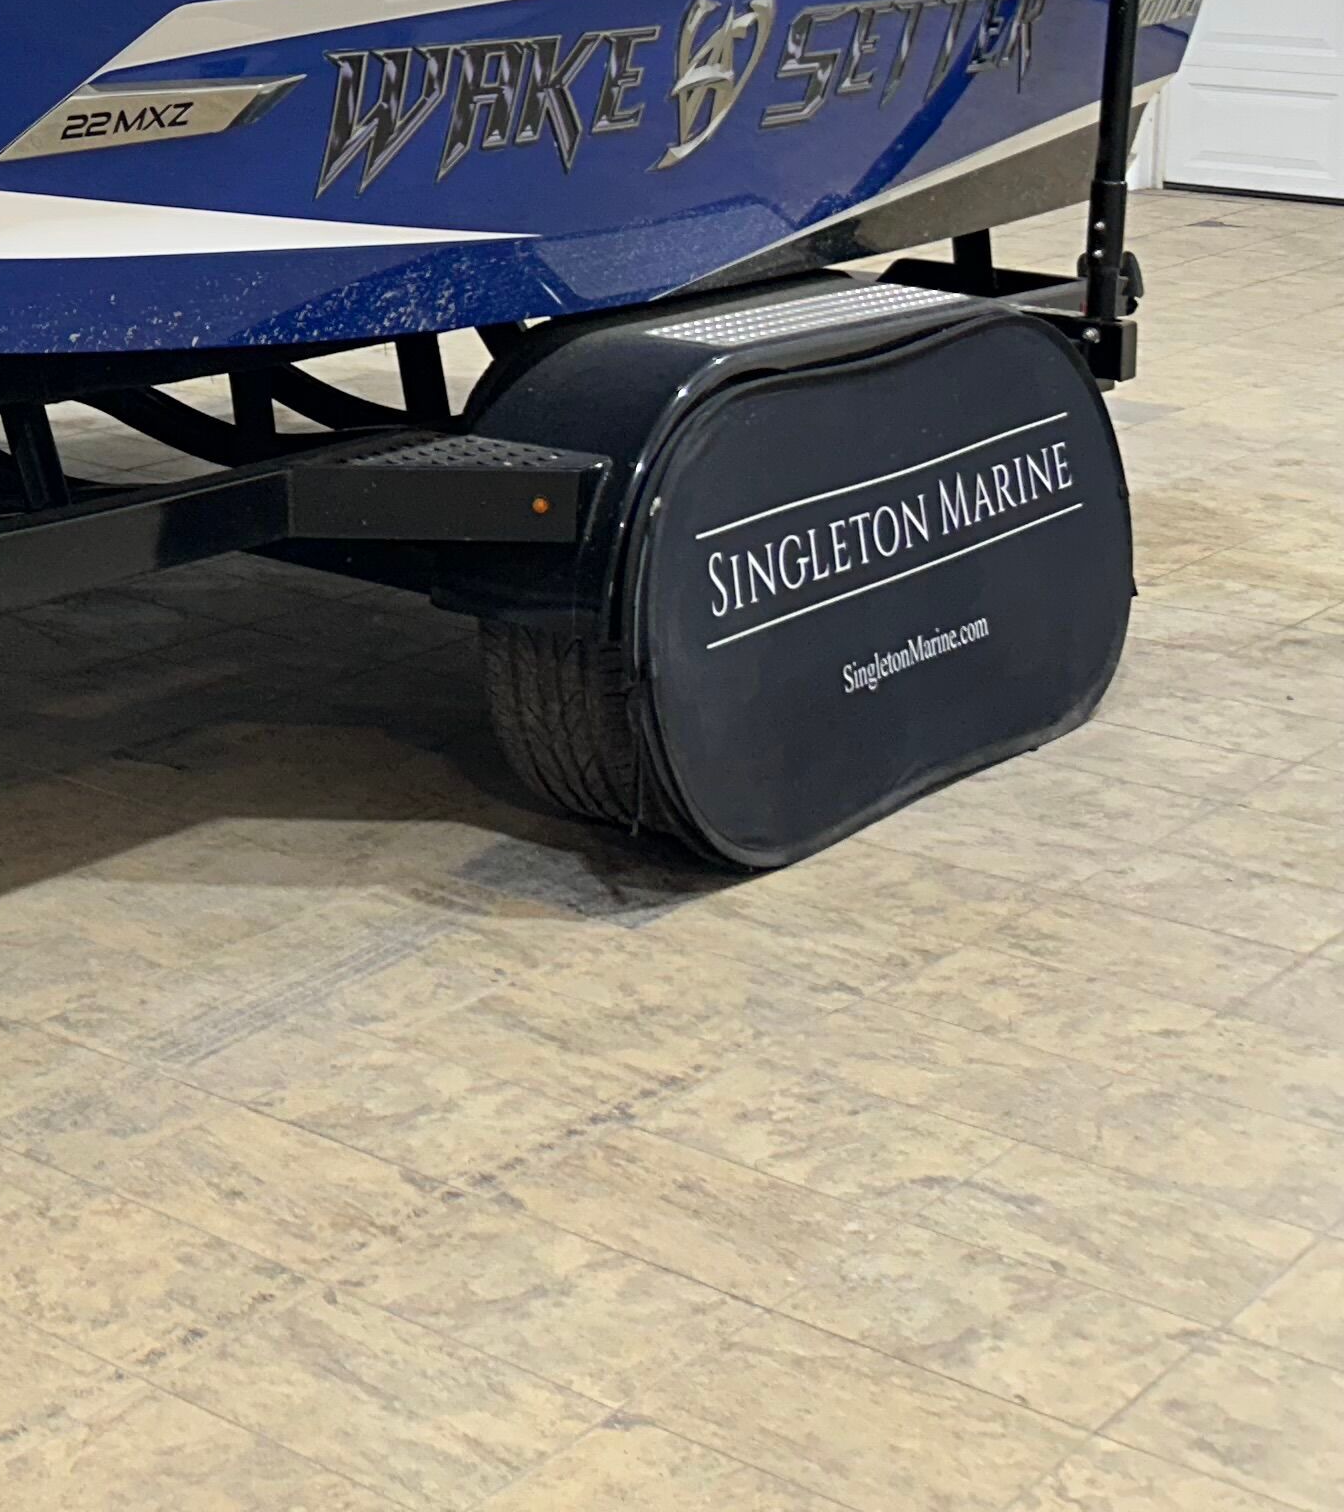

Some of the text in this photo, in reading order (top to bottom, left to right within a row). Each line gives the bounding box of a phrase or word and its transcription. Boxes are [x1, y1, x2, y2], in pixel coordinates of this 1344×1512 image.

[315, 25, 660, 199] WAKE
[708, 440, 1074, 617] SINGLETON MARINE
[842, 616, 990, 694] SingletonMarine.com
